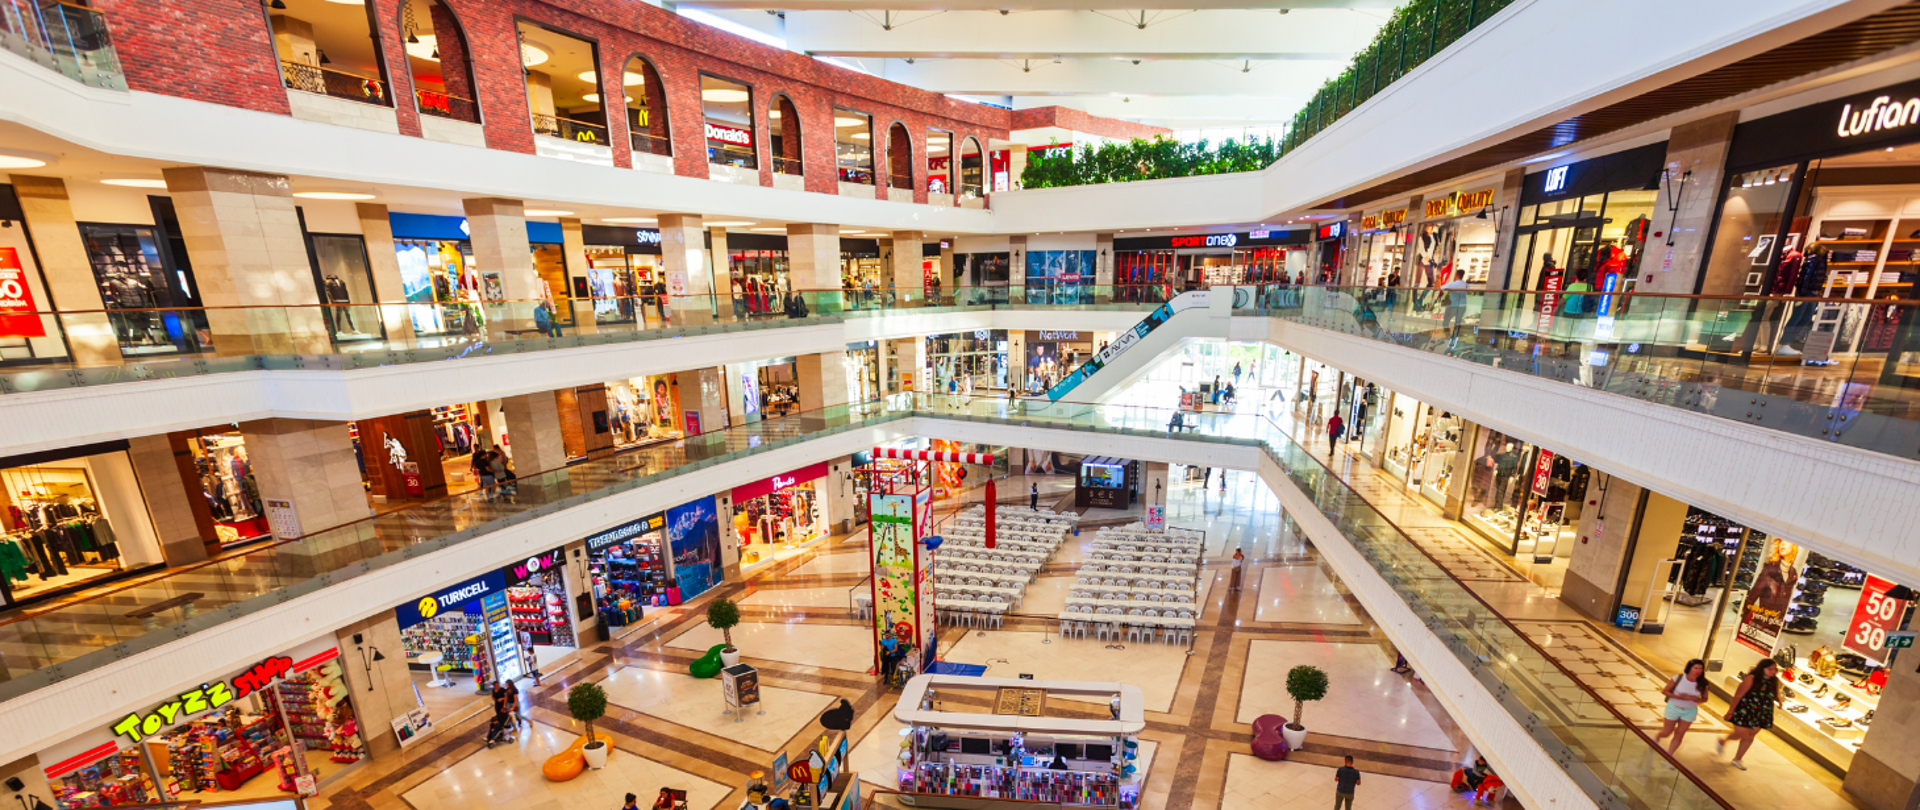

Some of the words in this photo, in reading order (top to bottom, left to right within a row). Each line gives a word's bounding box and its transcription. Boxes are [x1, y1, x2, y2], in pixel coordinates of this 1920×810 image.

[1837, 95, 1920, 137] Lufian
[706, 124, 750, 144] Donald's
[1544, 165, 1569, 192] LOFT
[0, 280, 23, 299] 0
[438, 580, 490, 608] TURKCELL
[1865, 591, 1896, 621] 50
[1619, 610, 1639, 620] 300
[1855, 622, 1886, 652] 30
[232, 656, 293, 698] SHOP
